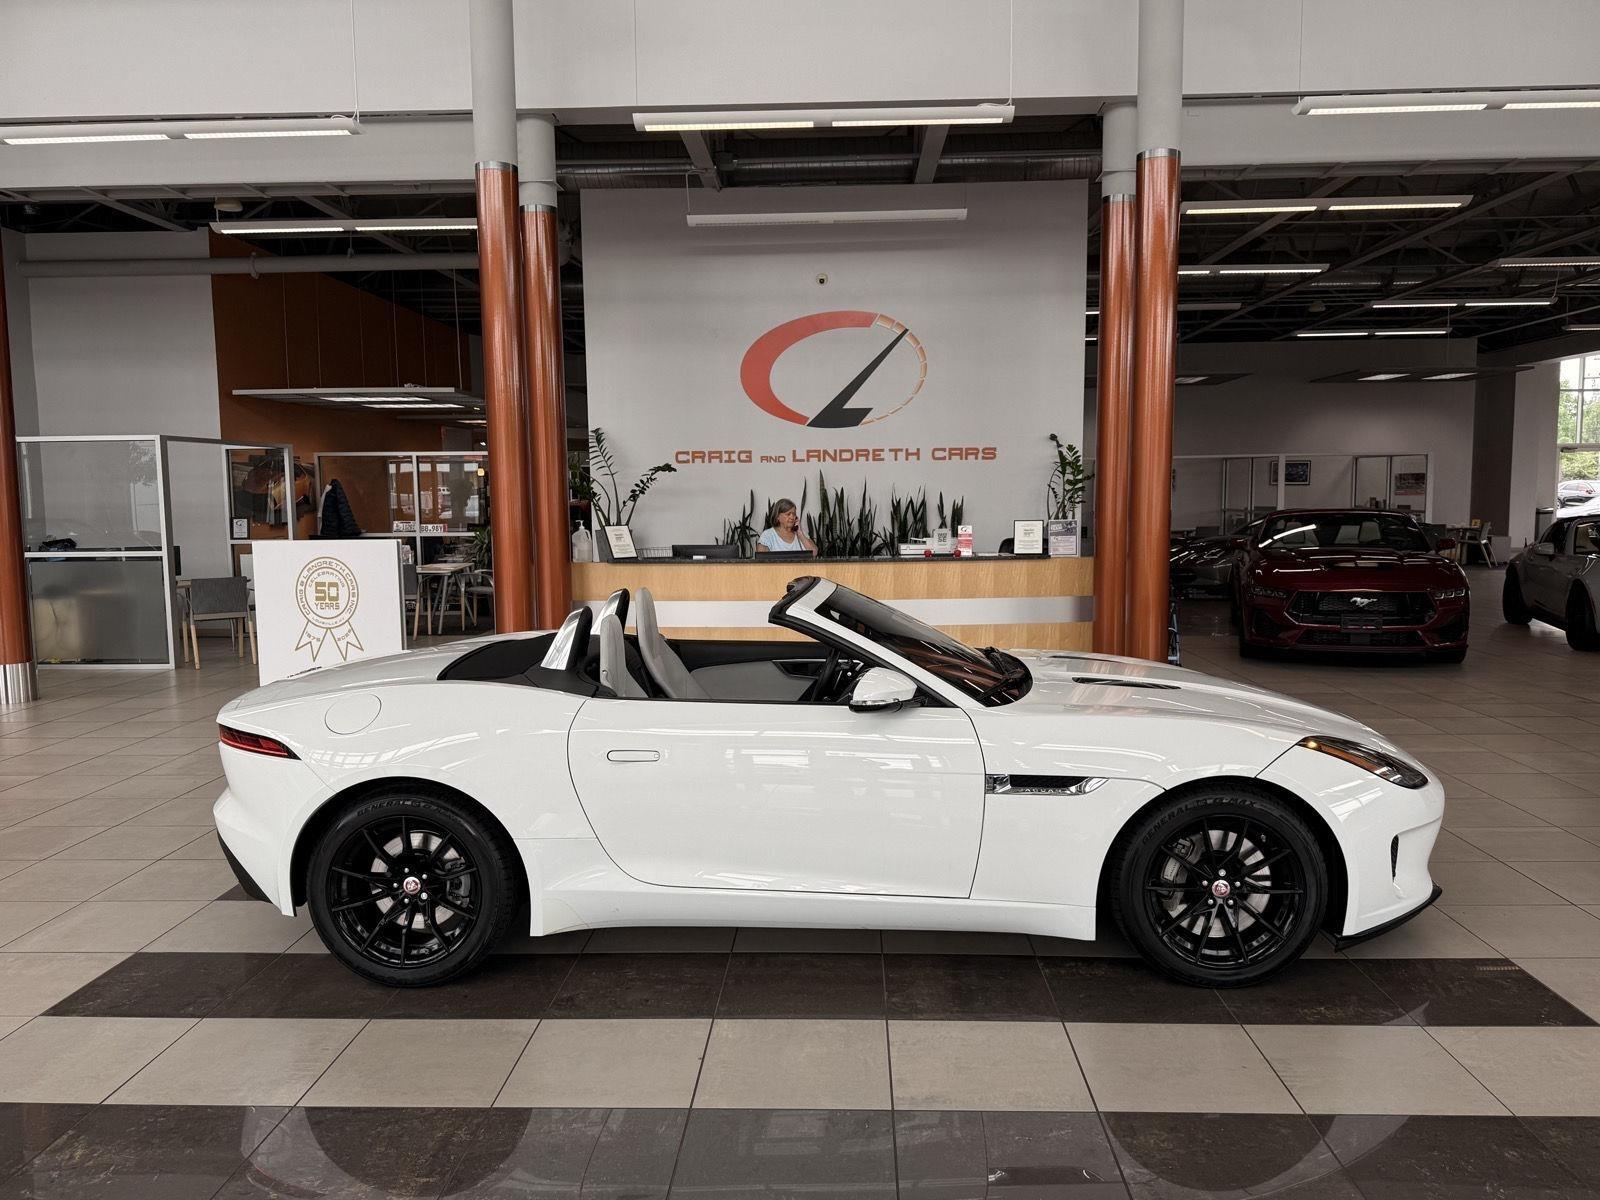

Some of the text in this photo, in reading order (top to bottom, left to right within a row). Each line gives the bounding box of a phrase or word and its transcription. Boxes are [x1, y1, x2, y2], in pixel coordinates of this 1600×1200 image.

[675, 447, 997, 464] CRAIG AND LANDRETH CARS
[303, 561, 346, 579] LANDRETH
[315, 581, 340, 602] 50
[345, 572, 357, 598] CARS
[298, 589, 311, 616] CRAIG
[314, 602, 340, 610] YEARS
